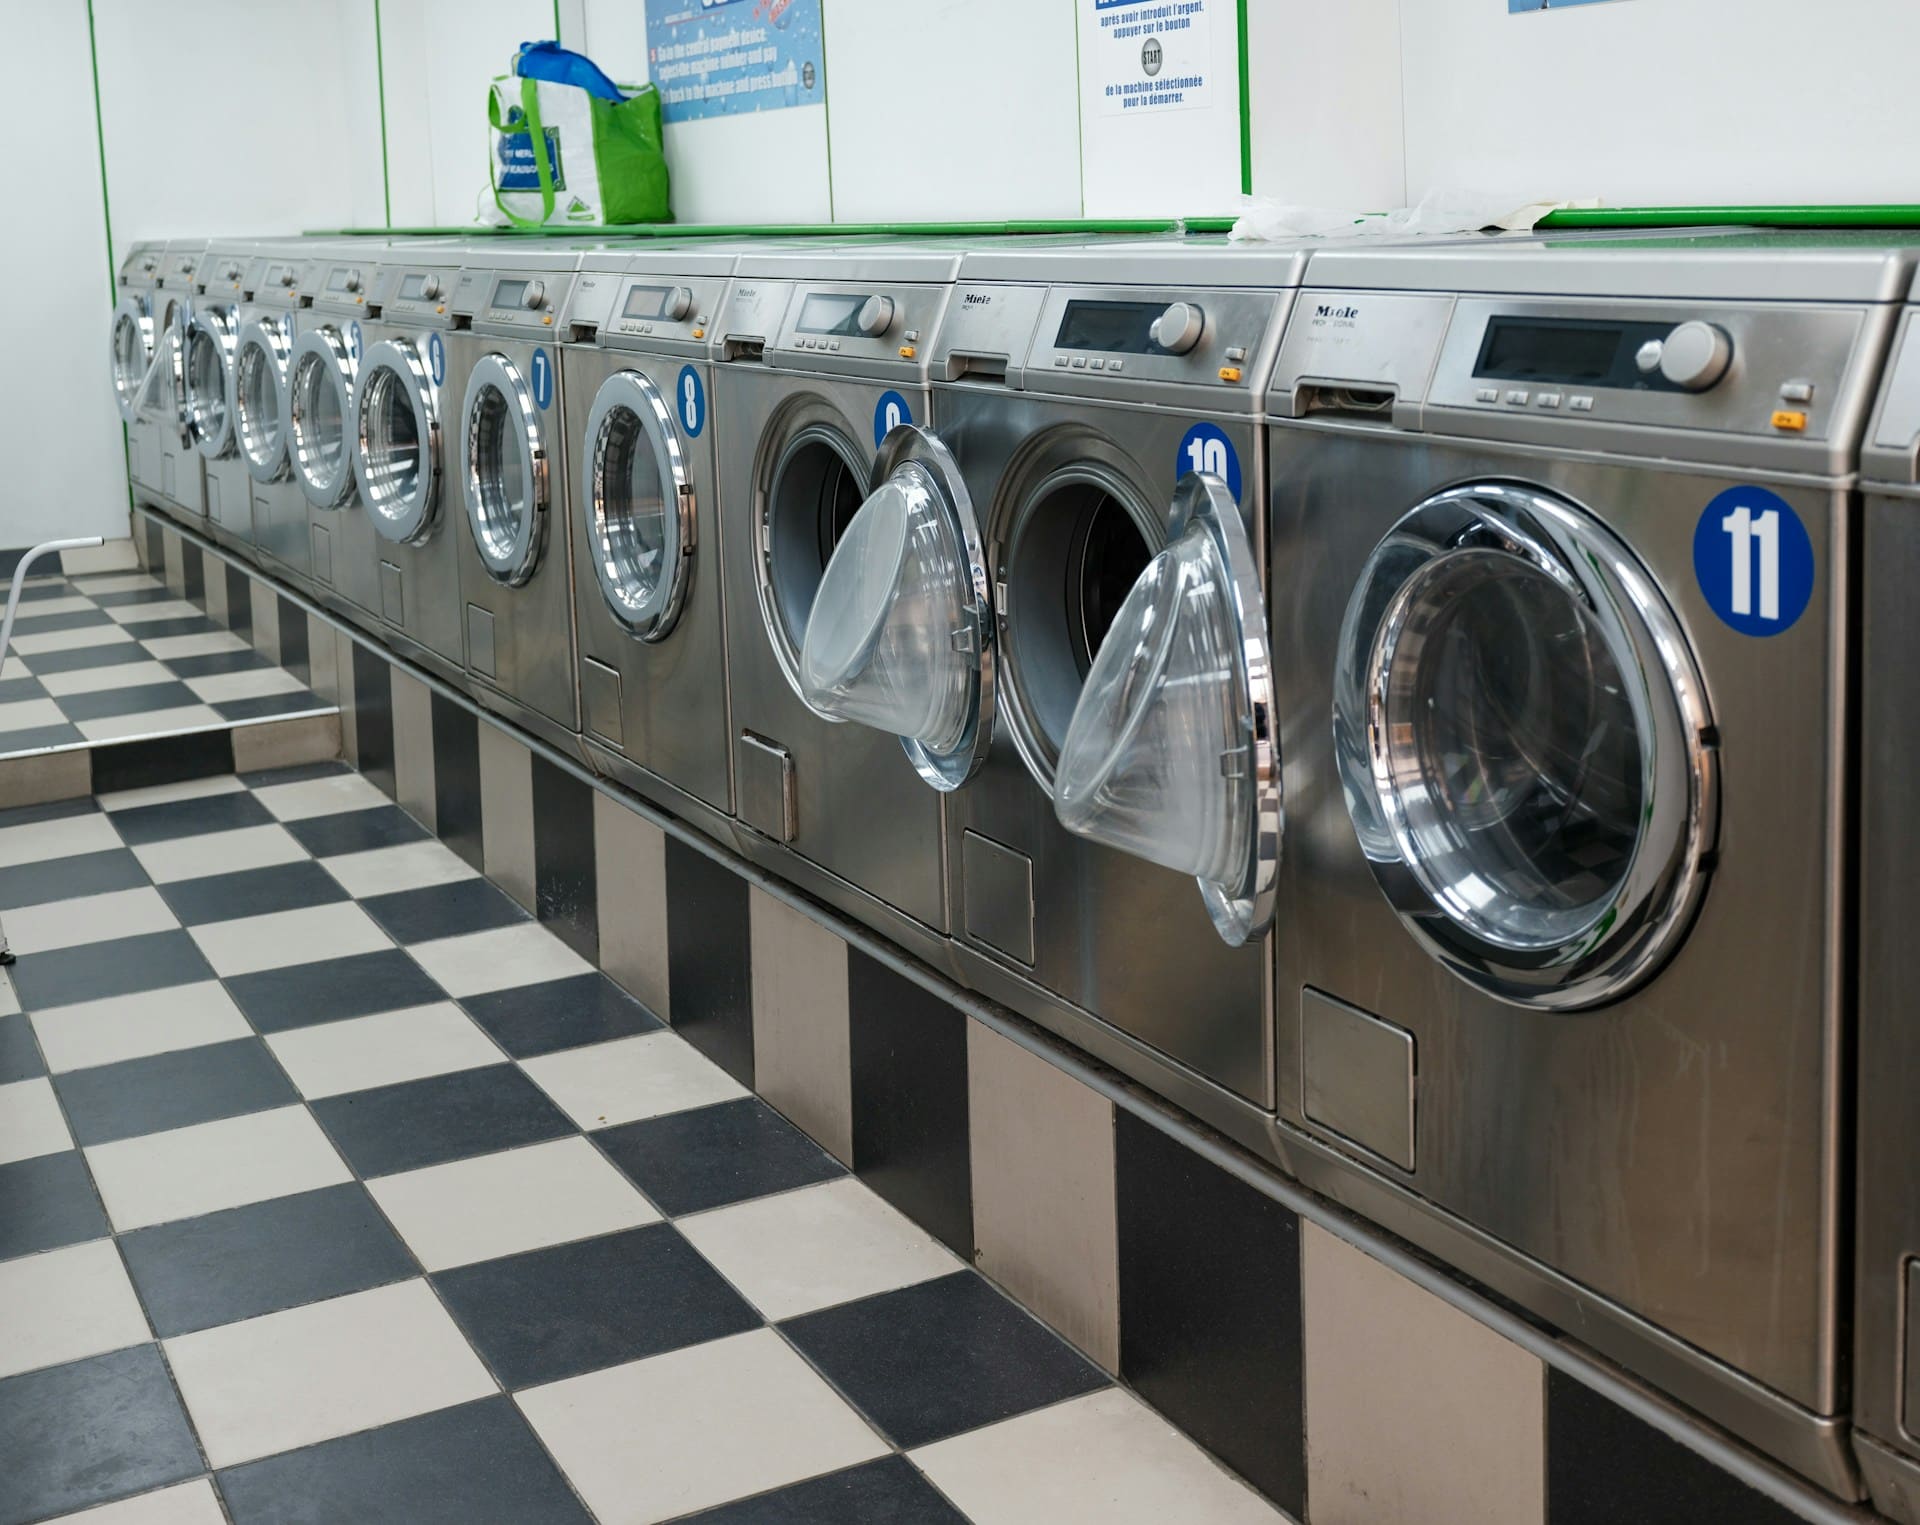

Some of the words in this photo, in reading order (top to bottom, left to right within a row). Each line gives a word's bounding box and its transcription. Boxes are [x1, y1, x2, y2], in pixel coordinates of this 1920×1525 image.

[1101, 13, 1120, 28] après
[1121, 11, 1138, 24] avoir
[1140, 5, 1172, 20] introduit
[1113, 25, 1141, 39] appuyer
[1143, 23, 1154, 34] sur
[1156, 20, 1163, 32] le
[1165, 18, 1190, 31] bouton
[1143, 49, 1161, 65] START
[1105, 84, 1114, 96] de
[1116, 83, 1122, 95] la
[1123, 80, 1153, 94] machine
[1123, 95, 1139, 109] pour
[1141, 94, 1148, 106] la
[432, 339, 441, 382] 6
[535, 356, 546, 402] 7
[684, 374, 697, 430] 8
[1722, 506, 1779, 621] 11
